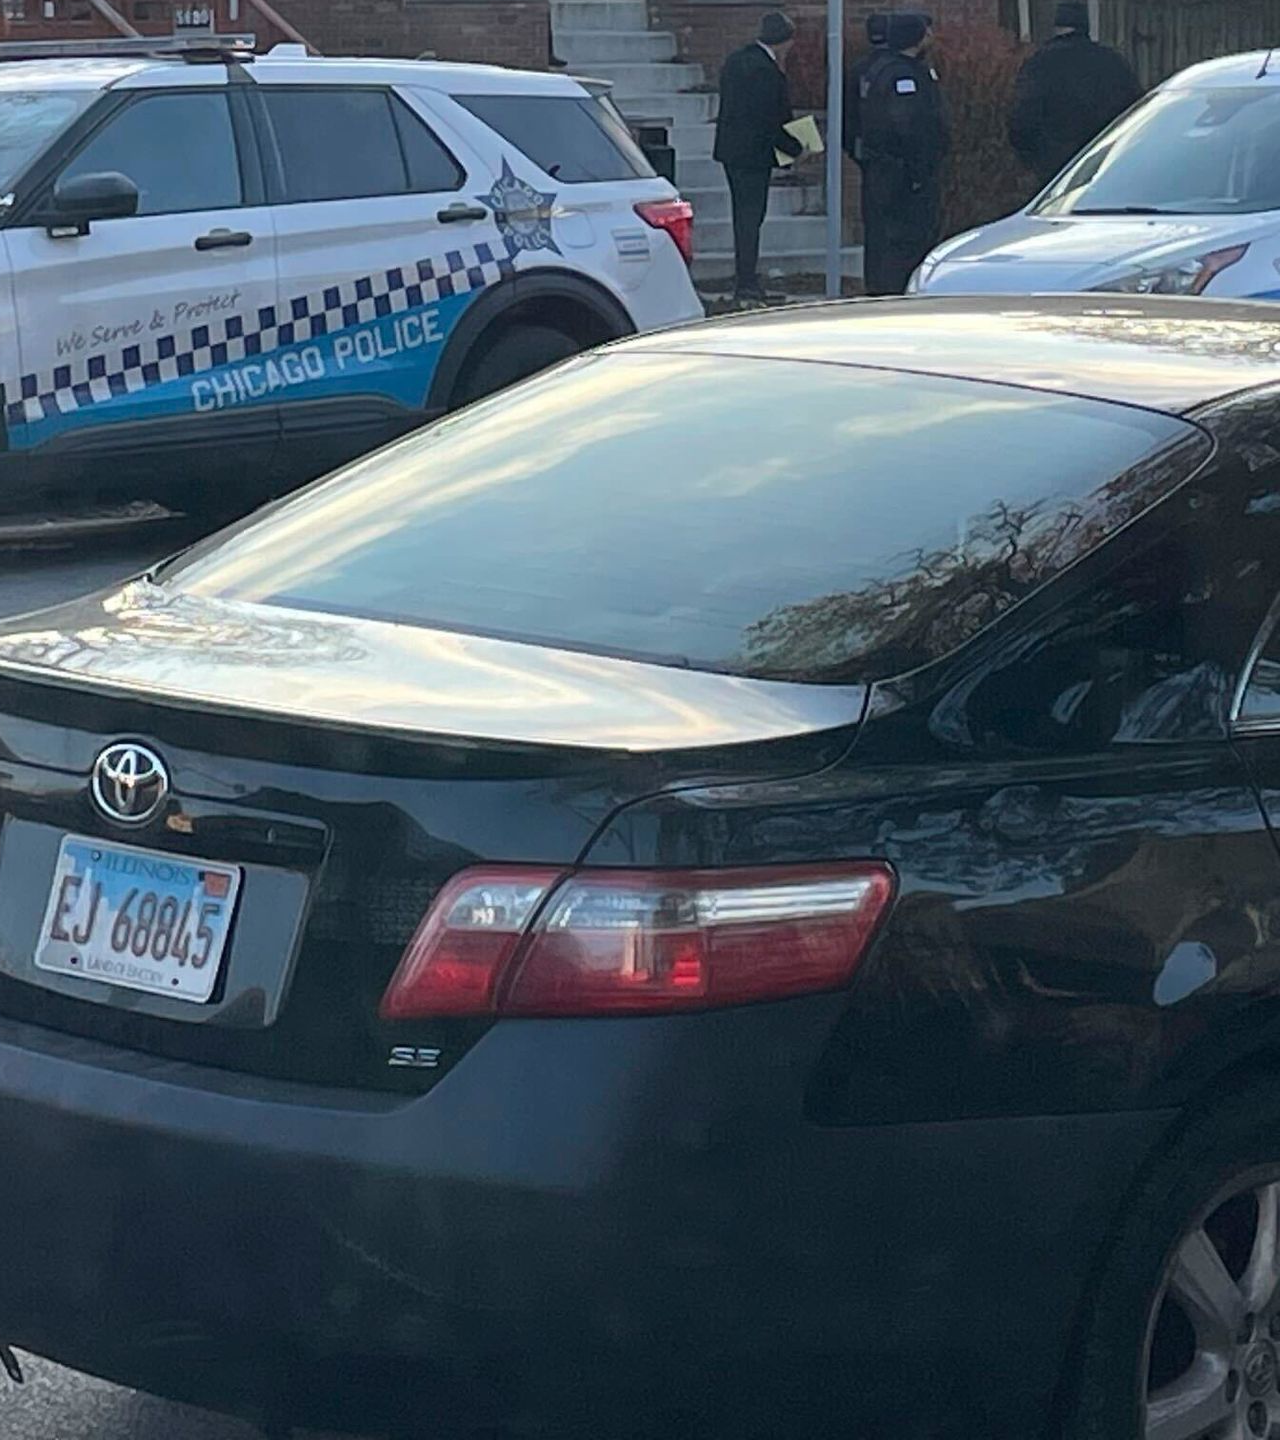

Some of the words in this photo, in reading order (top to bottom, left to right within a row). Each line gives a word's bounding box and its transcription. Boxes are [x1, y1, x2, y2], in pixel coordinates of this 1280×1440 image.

[56, 331, 87, 357] We
[90, 319, 144, 348] Serve
[148, 310, 165, 331] &
[173, 291, 241, 325] Protect
[191, 346, 326, 412] CHICAGO
[333, 308, 444, 370] POLICE
[100, 854, 192, 887] ILLINOIS
[49, 874, 103, 945] EJ
[110, 887, 220, 969] 68845
[388, 1046, 441, 1067] SE
